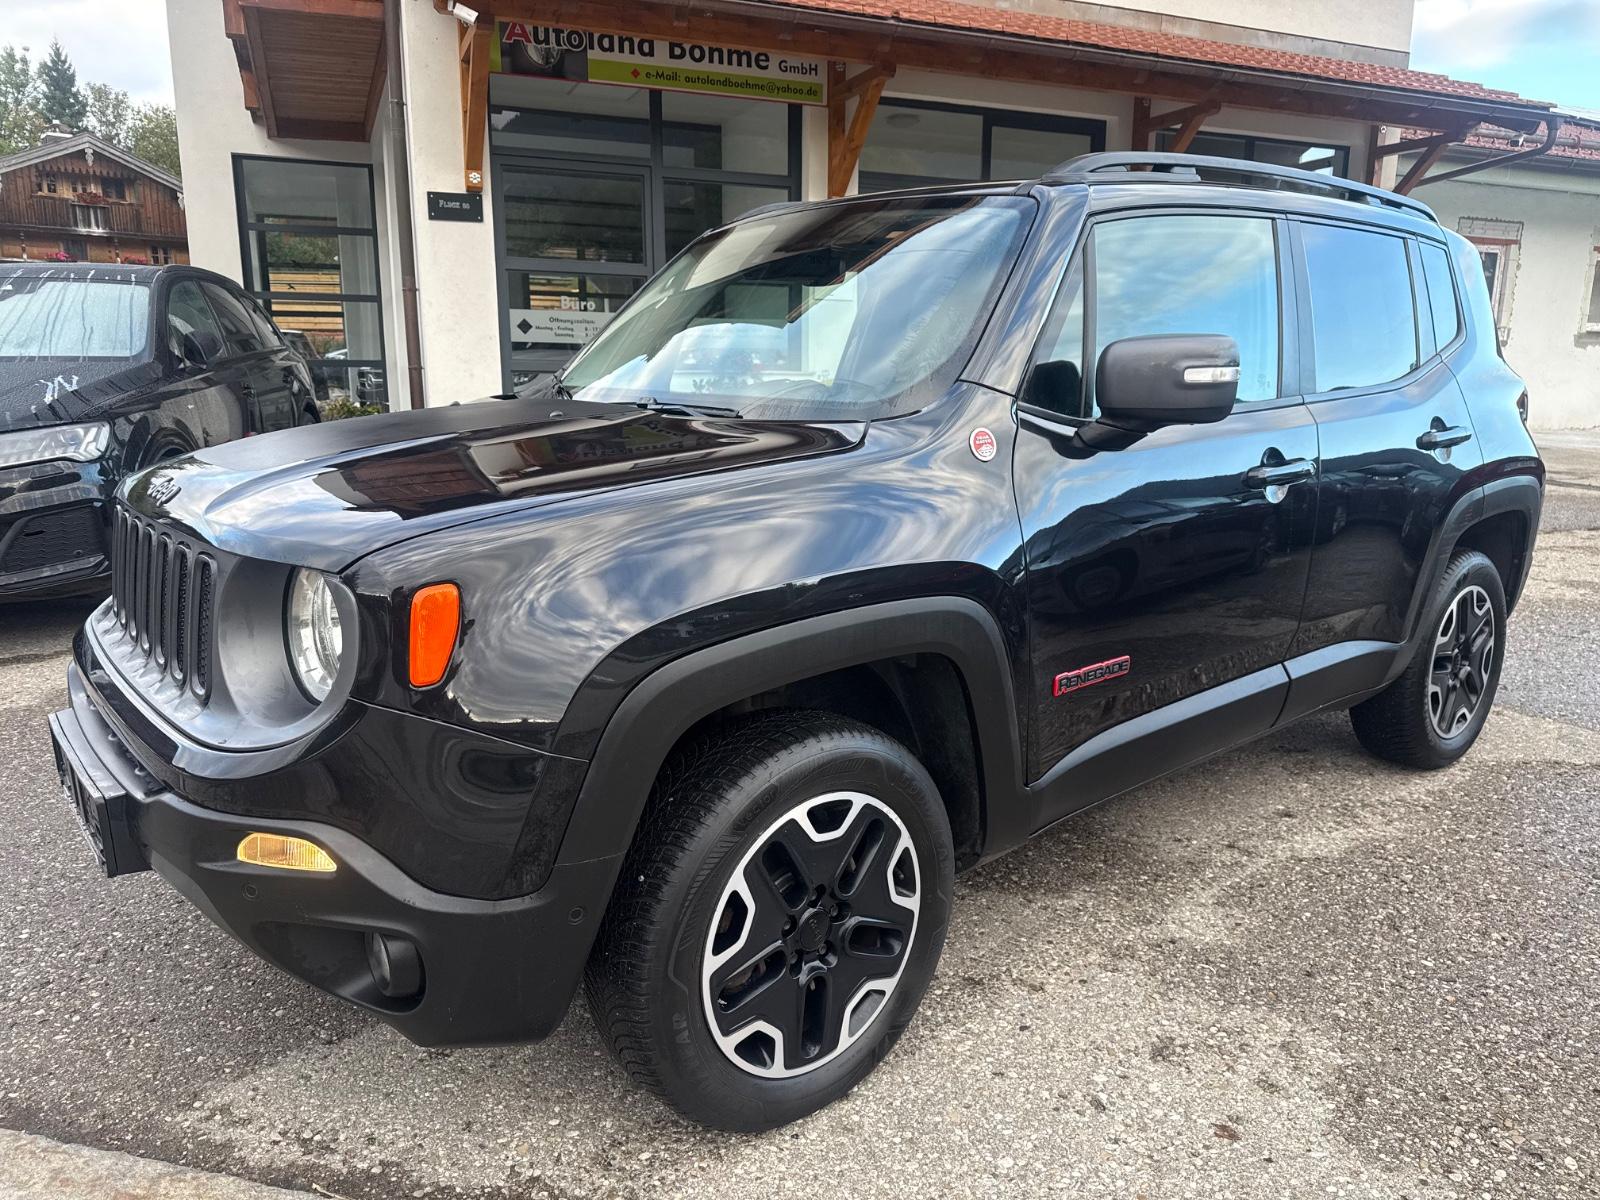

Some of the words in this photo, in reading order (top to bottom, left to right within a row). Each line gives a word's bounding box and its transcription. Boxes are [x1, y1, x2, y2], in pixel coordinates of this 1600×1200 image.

[778, 59, 818, 77] GmbH
[645, 70, 681, 83] e-Mail:
[684, 75, 818, 97] autolandboehme@yahoo.de
[560, 295, 596, 311] Büro
[1056, 657, 1130, 696] RENEGADE
